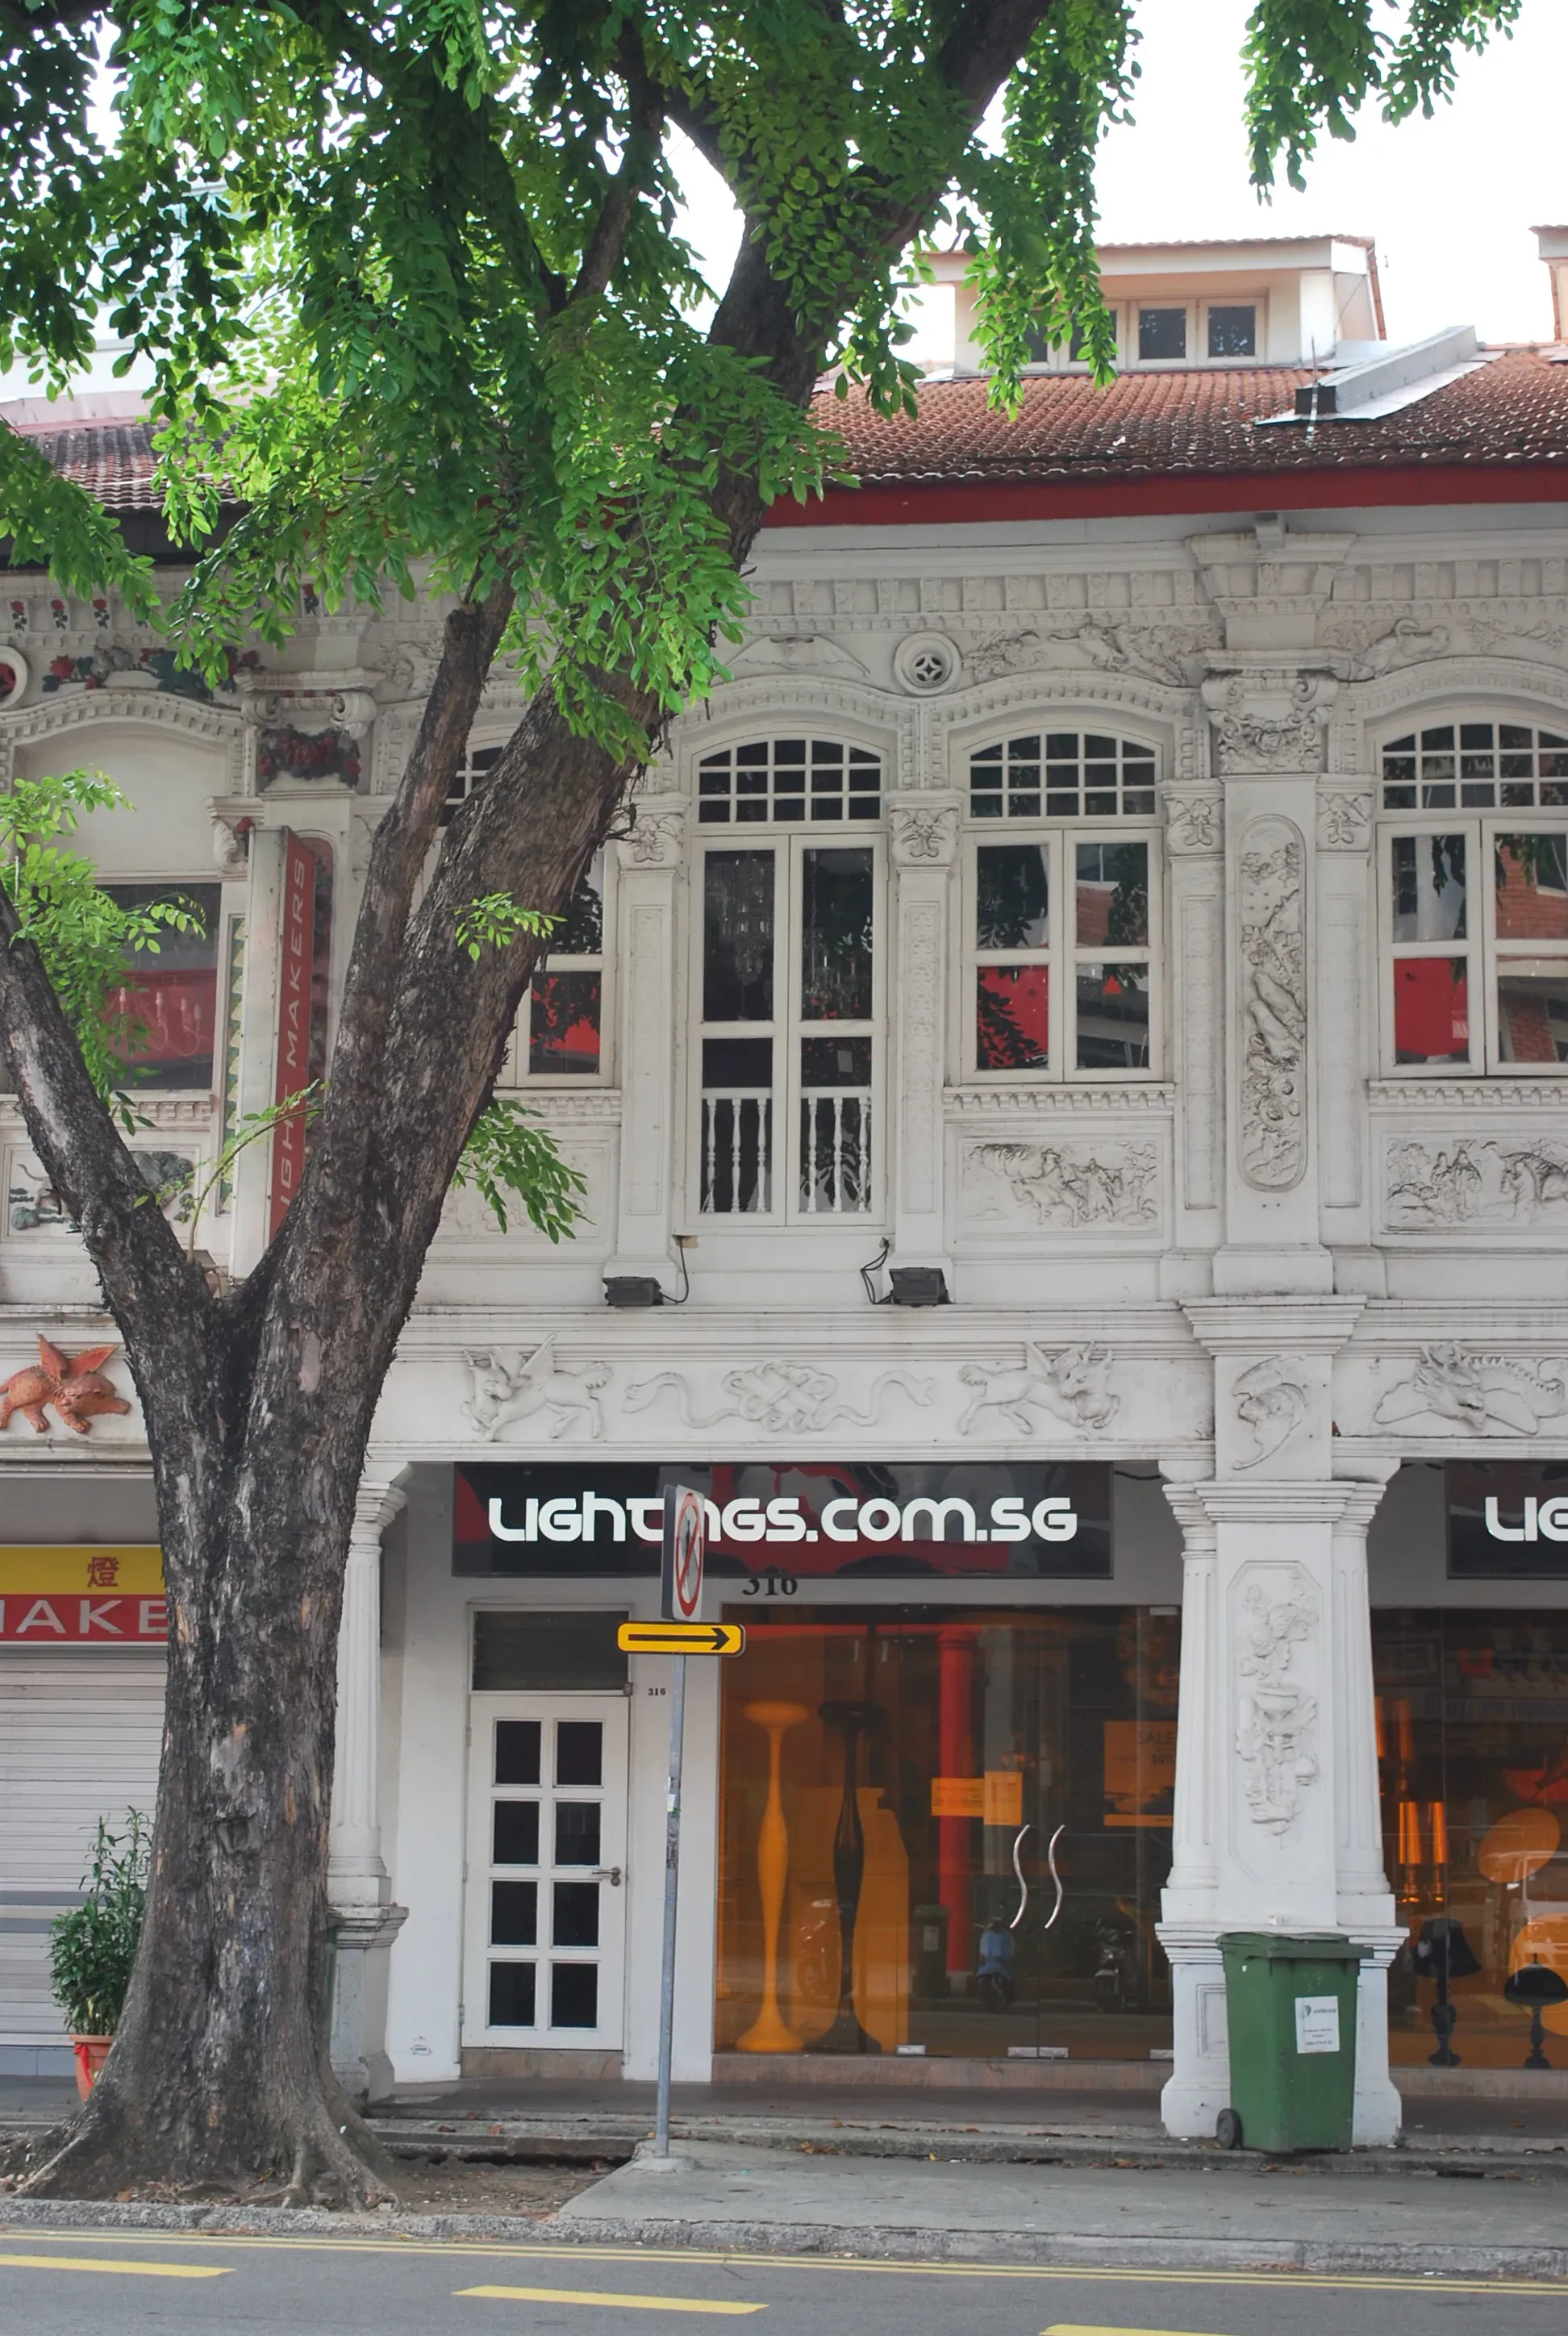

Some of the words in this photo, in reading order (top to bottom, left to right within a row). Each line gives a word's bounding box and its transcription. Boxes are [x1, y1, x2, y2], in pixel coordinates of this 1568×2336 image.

[286, 858, 306, 1068] MAKERS
[280, 1084, 294, 1206] IGH
[86, 1556, 119, 1587] 燈
[0, 1599, 169, 1634] AKE
[648, 1687, 666, 1696] 316
